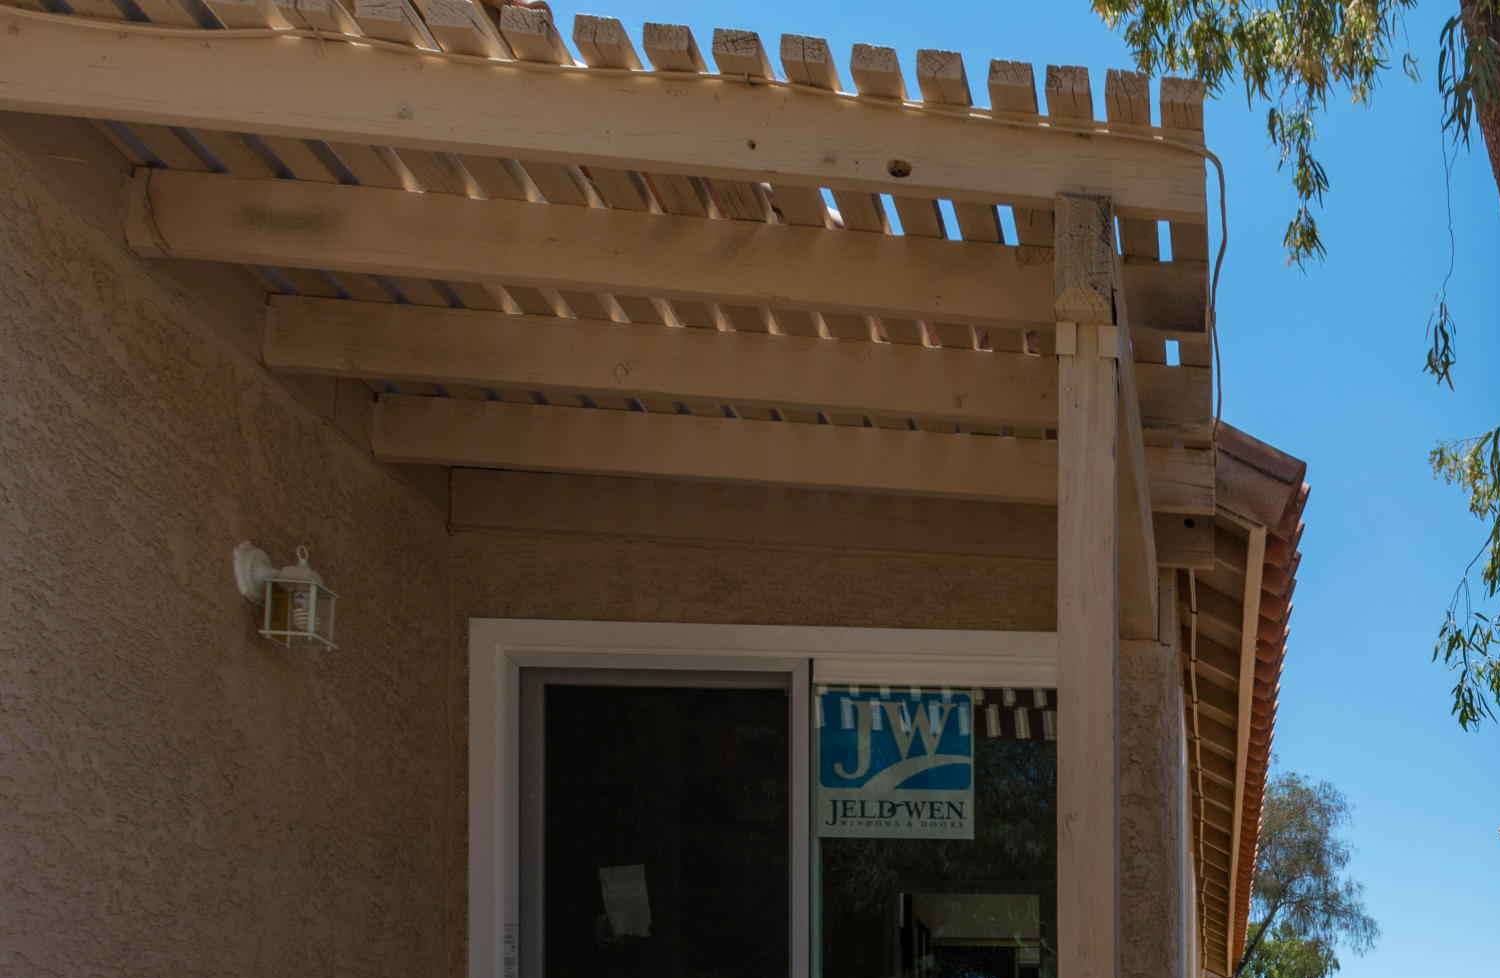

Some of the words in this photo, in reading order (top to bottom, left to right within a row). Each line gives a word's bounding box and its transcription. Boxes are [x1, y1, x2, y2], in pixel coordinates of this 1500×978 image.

[834, 701, 957, 779] JW
[840, 820, 900, 828] WINDOWS
[921, 821, 964, 829] DOORS
